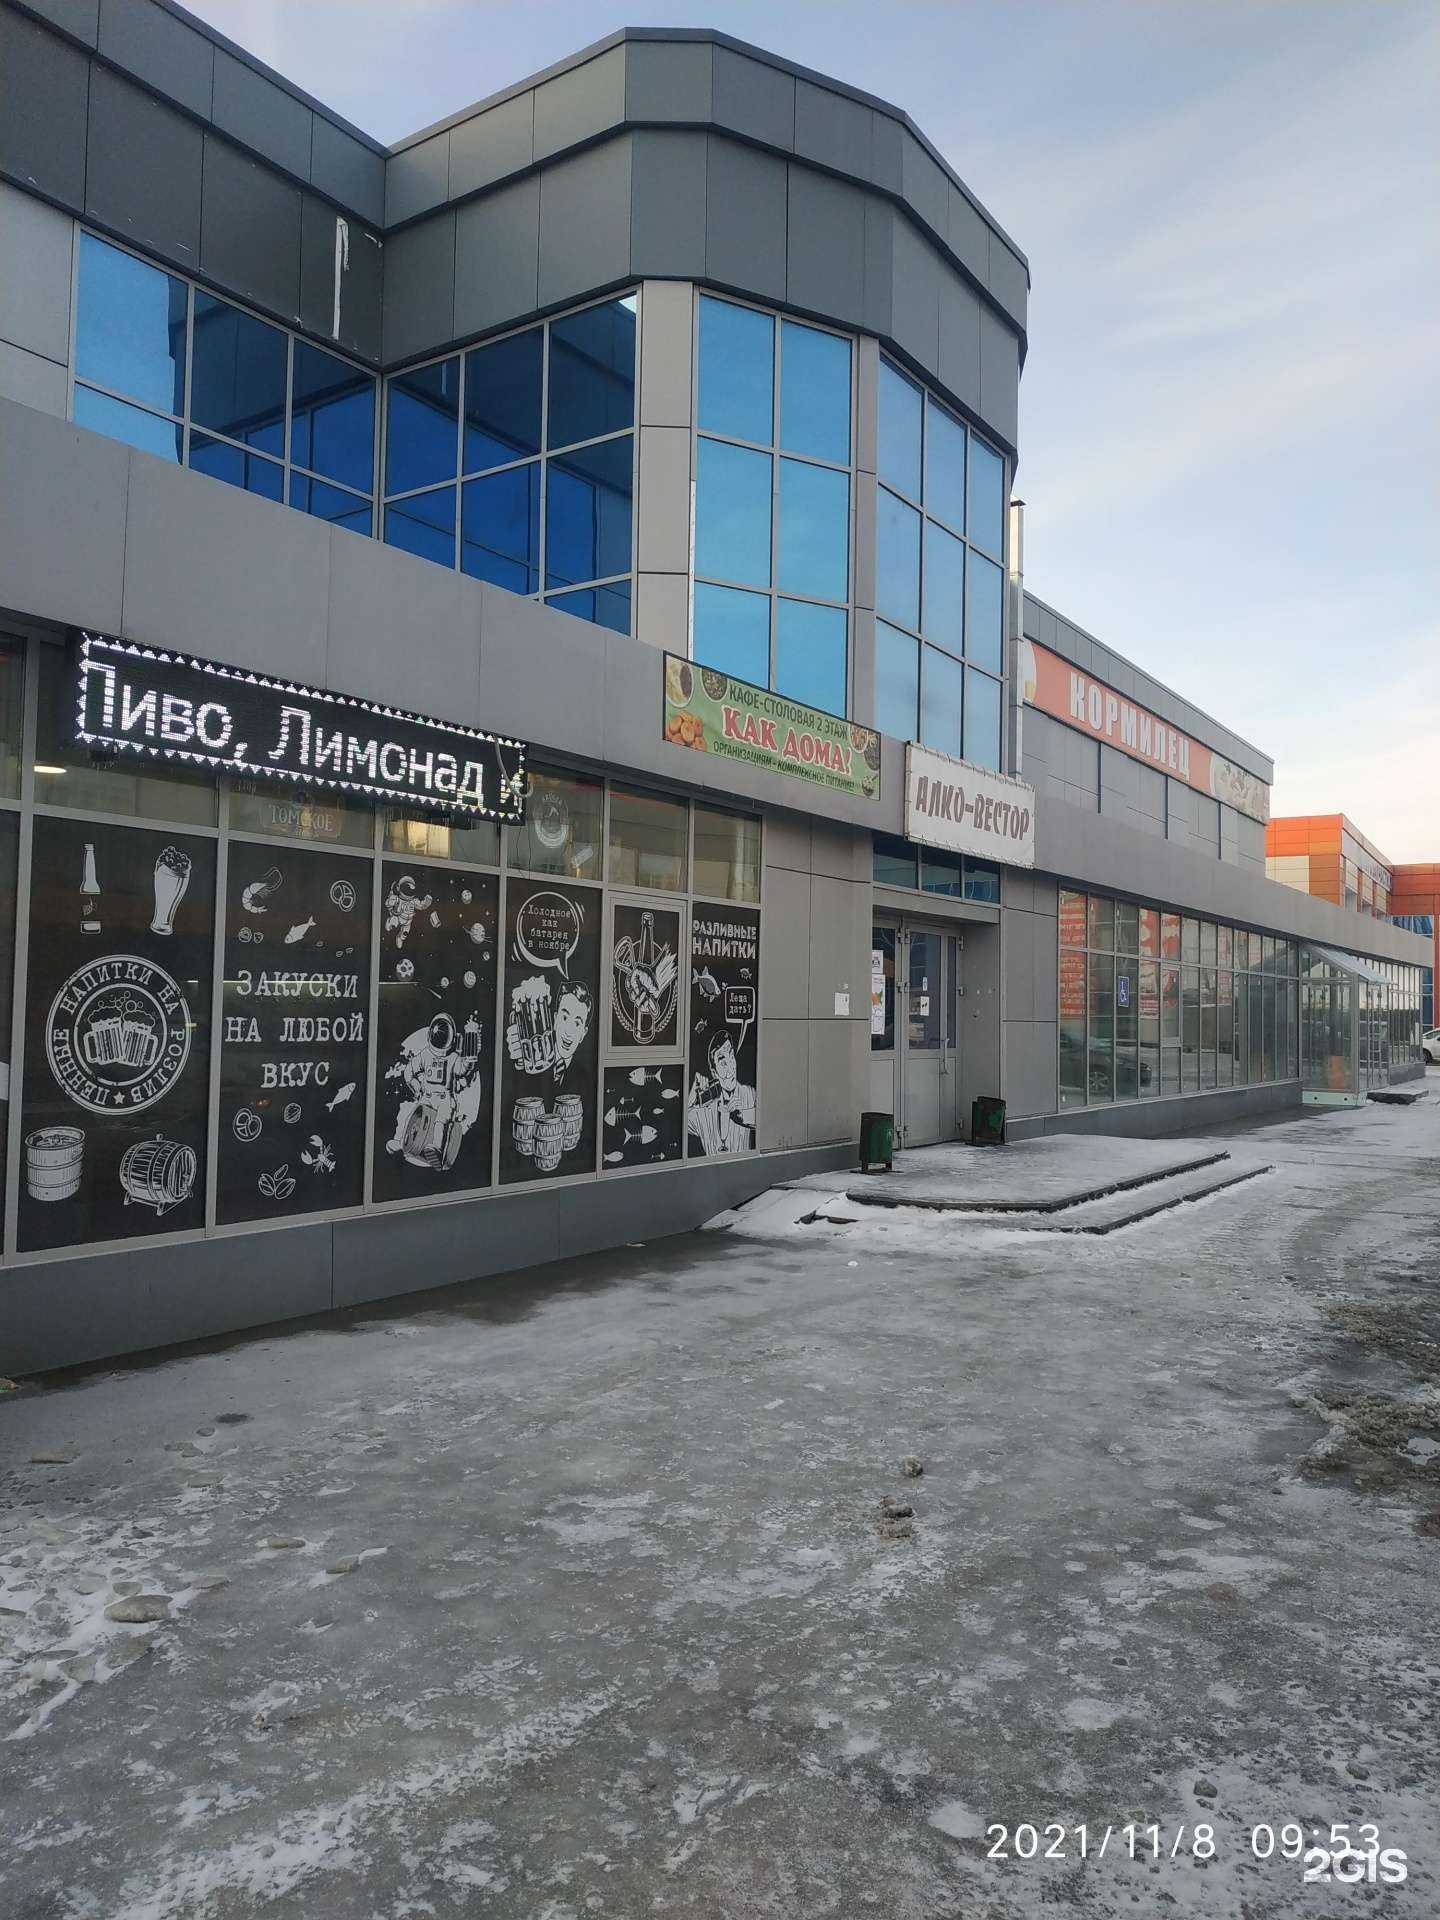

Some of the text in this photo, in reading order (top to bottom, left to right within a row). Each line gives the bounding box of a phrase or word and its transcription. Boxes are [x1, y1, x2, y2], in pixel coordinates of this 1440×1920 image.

[83, 659, 248, 765] Пиво,
[268, 705, 485, 808] Лимонад
[729, 685, 849, 740] КАФЕ-СТОЛОВАЯ 2 ЭТАЖ
[1070, 671, 1190, 782] КОРМИЛЕЦ
[713, 740, 772, 768] ОРГАНИЗАЦИЯМ
[777, 760, 825, 784] КОМПЛЕКСНОЕ
[722, 705, 852, 776] КАК ДОМА!
[692, 919, 757, 940] РАЗЛИВНЫЕ
[692, 936, 756, 960] НАПИТКИ
[60, 962, 153, 1015] НАПИТКИ
[157, 983, 180, 1016] НА
[236, 969, 358, 998] ЗАКУСКИ
[225, 1012, 364, 1042] НА ЛЮБОЙ
[130, 1028, 185, 1103] РОЗЛИВ
[260, 1061, 330, 1088] ВКУС
